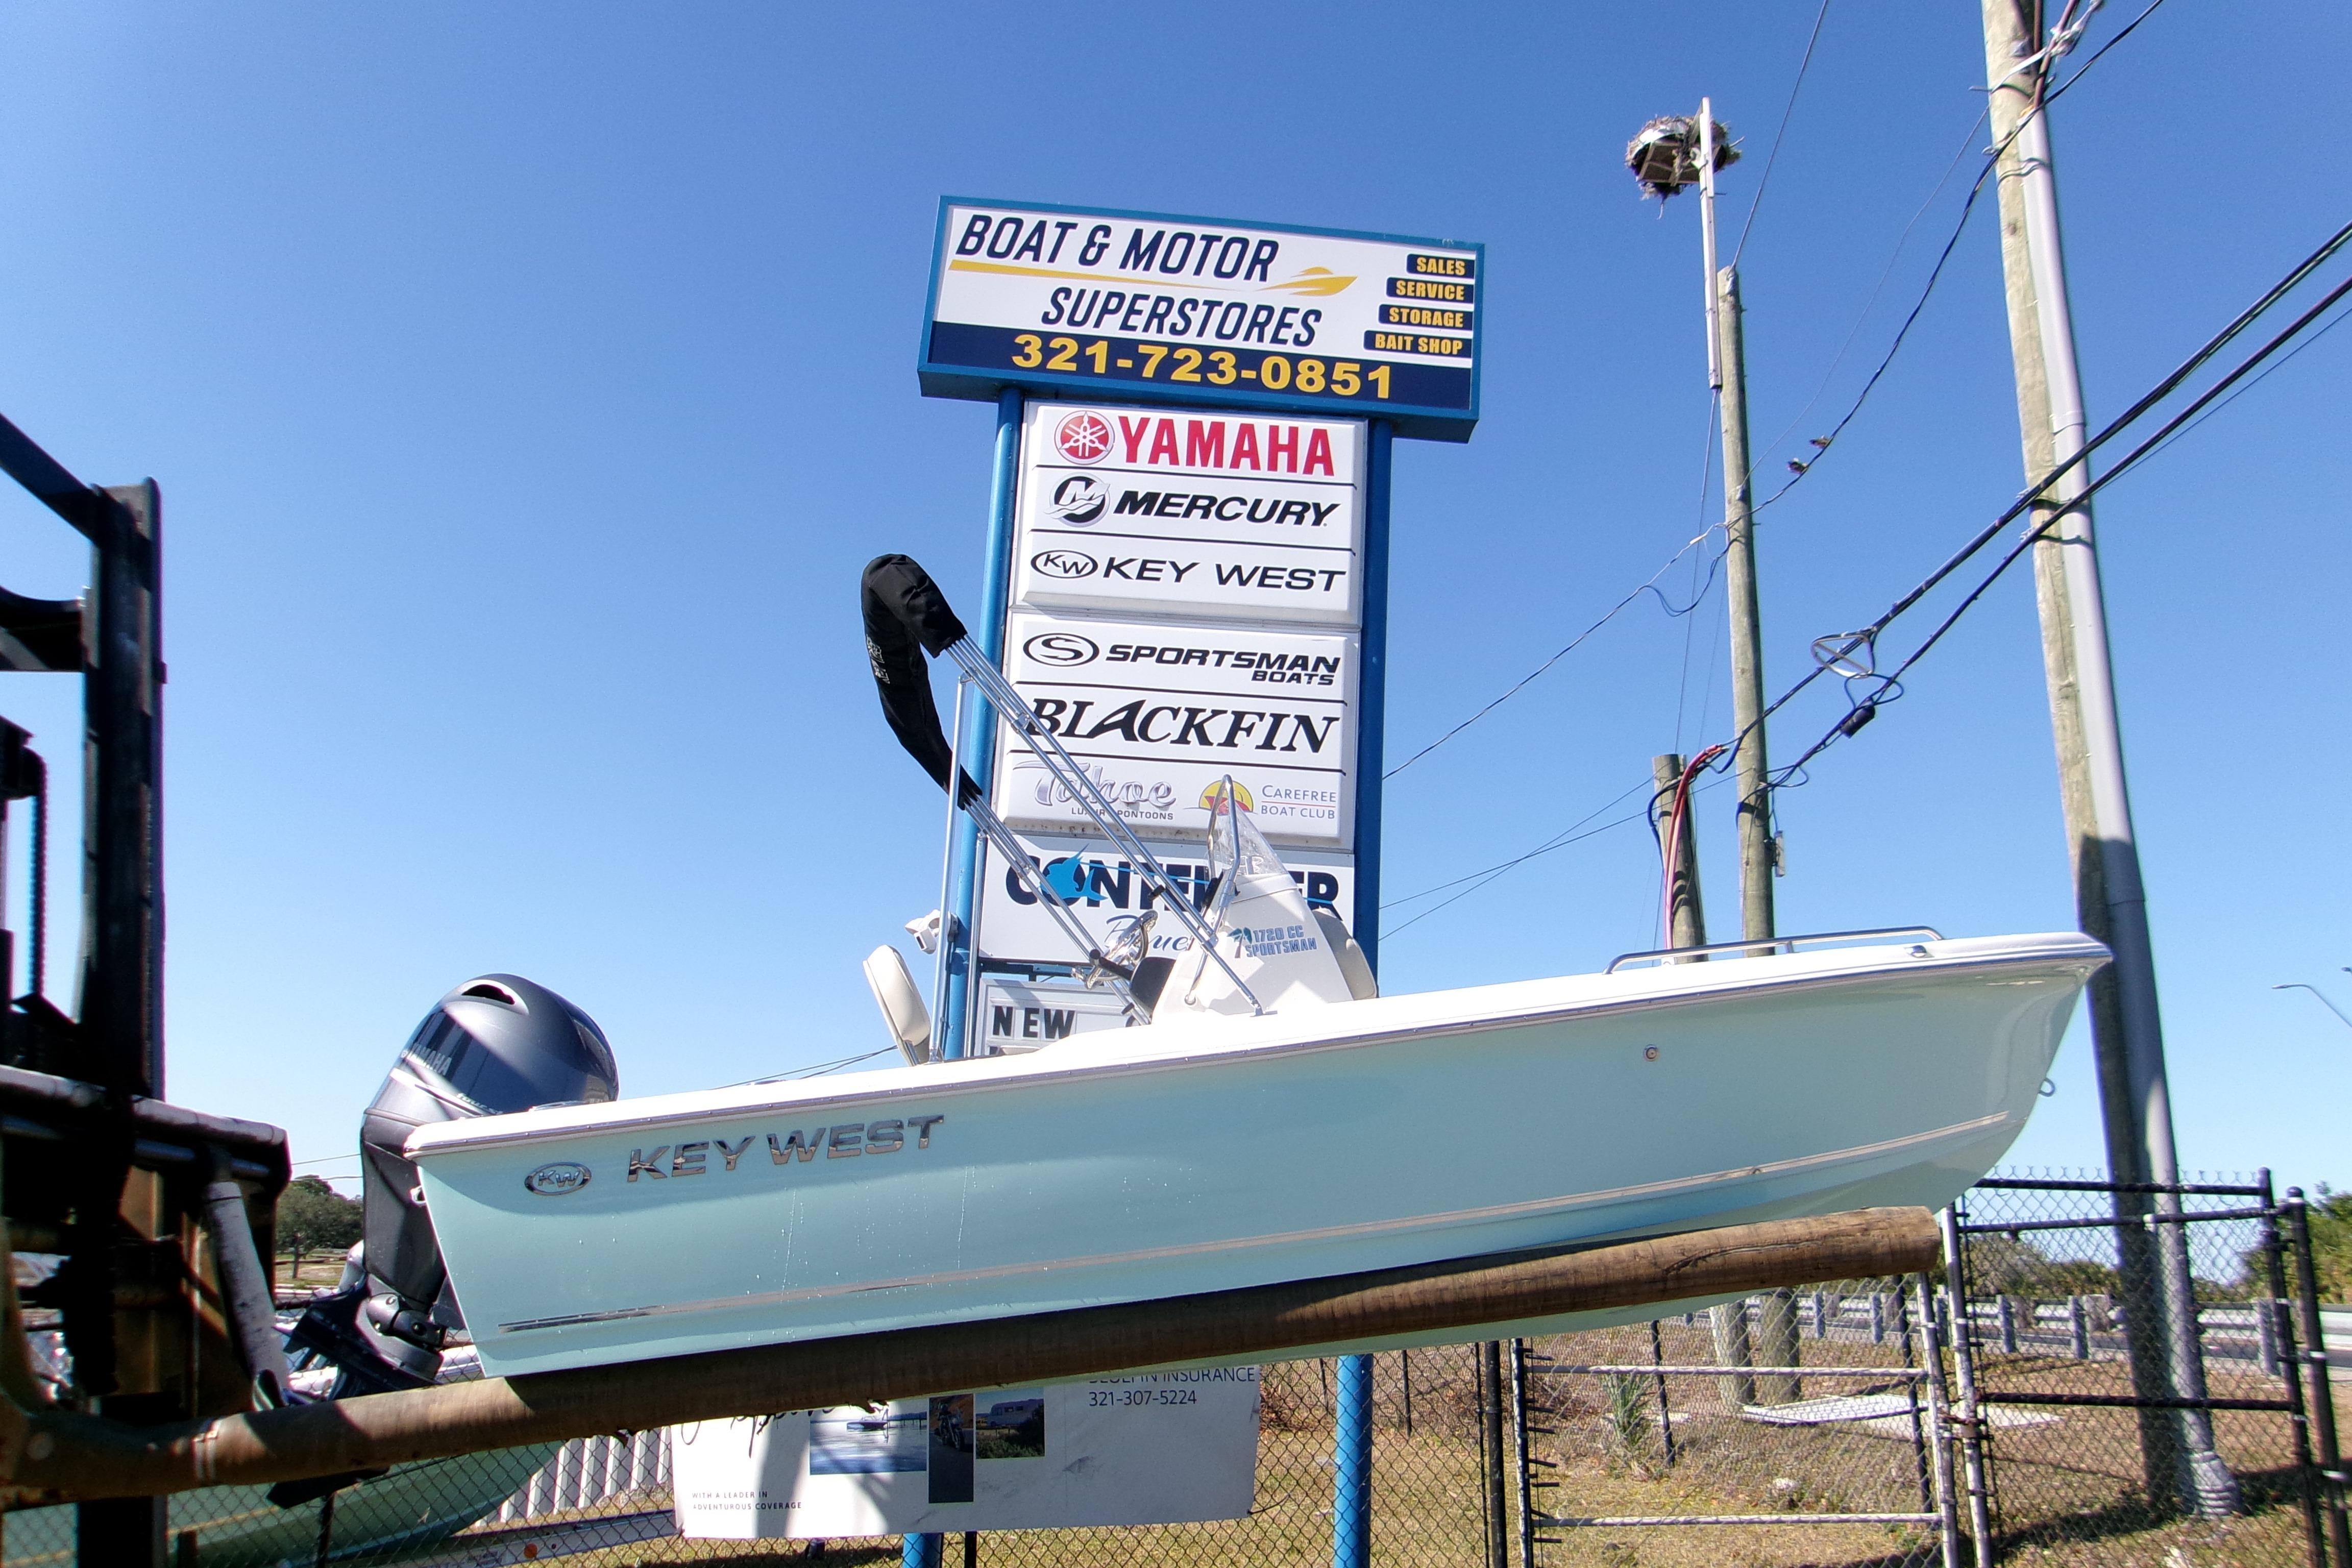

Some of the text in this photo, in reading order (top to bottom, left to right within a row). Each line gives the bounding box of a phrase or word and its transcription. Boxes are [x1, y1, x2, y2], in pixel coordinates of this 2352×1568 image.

[955, 214, 1279, 282] BOAT & MOTOR
[1416, 257, 1466, 276] SALES
[1396, 280, 1465, 301] SERVICE
[1041, 287, 1322, 348] SUPERSTORES
[1389, 307, 1464, 328] STORAGE
[1375, 333, 1463, 355] BAIT SHOP
[1012, 334, 1390, 399] 321-723-0851
[1118, 415, 1335, 476] YAMAHA
[1113, 491, 1340, 527] MERCURY
[1104, 556, 1201, 583] KEY
[1215, 564, 1346, 592] WEST
[1106, 645, 1341, 673] SPORTSMAN
[1251, 670, 1335, 686] BOATS
[1026, 698, 1340, 753] BLACKFIN
[1013, 760, 1176, 807] Tahoe
[1117, 810, 1173, 820] PONTOONS
[1261, 805, 1335, 819] BOAT CLUB
[1253, 925, 1304, 943] 1720 CC
[1244, 938, 1317, 958] SPORTSMAN
[992, 1006, 1075, 1039] NEW
[627, 1135, 755, 1182] KEY
[766, 1114, 944, 1165] WEST
[1089, 1390, 1197, 1407] 321-307-5224
[755, 1501, 802, 1510] COVERAGE
